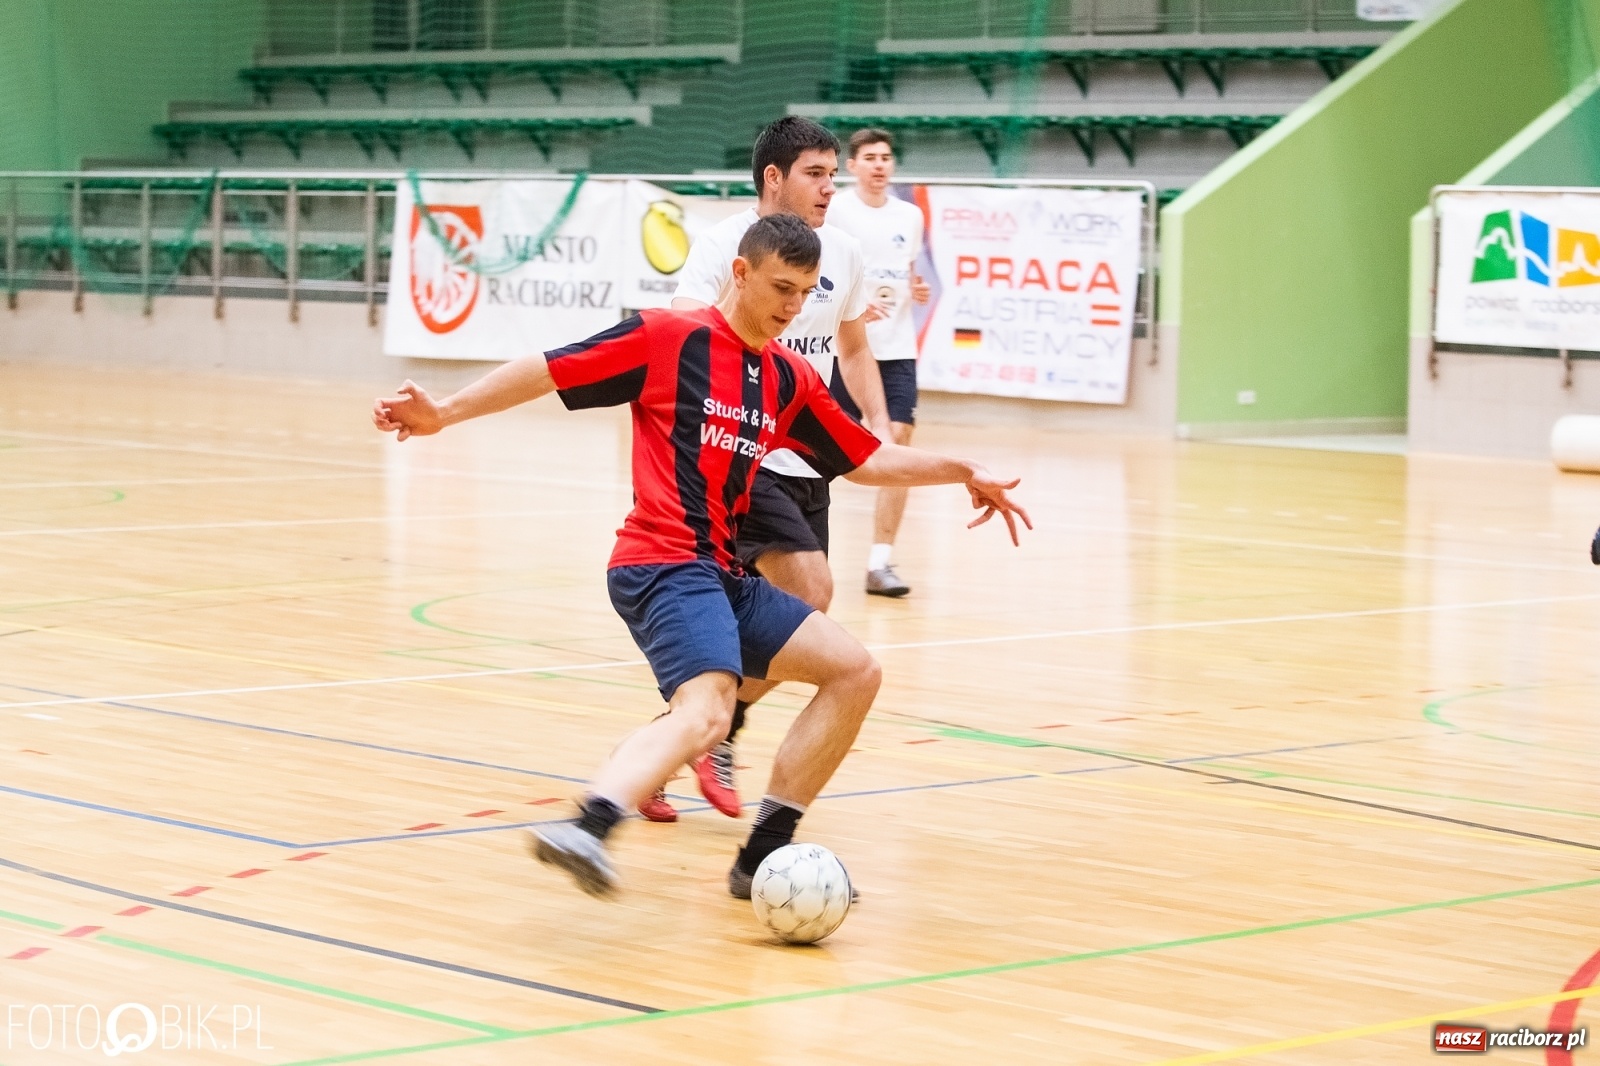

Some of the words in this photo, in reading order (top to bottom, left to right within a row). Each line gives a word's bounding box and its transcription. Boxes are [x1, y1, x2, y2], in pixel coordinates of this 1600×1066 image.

[1050, 212, 1123, 233] WORK
[956, 256, 1120, 294] PRACA
[954, 296, 1083, 325] AUSTRIA
[988, 328, 1122, 359] NIEMCY
[703, 398, 748, 423] Stuck
[751, 409, 759, 427] &
